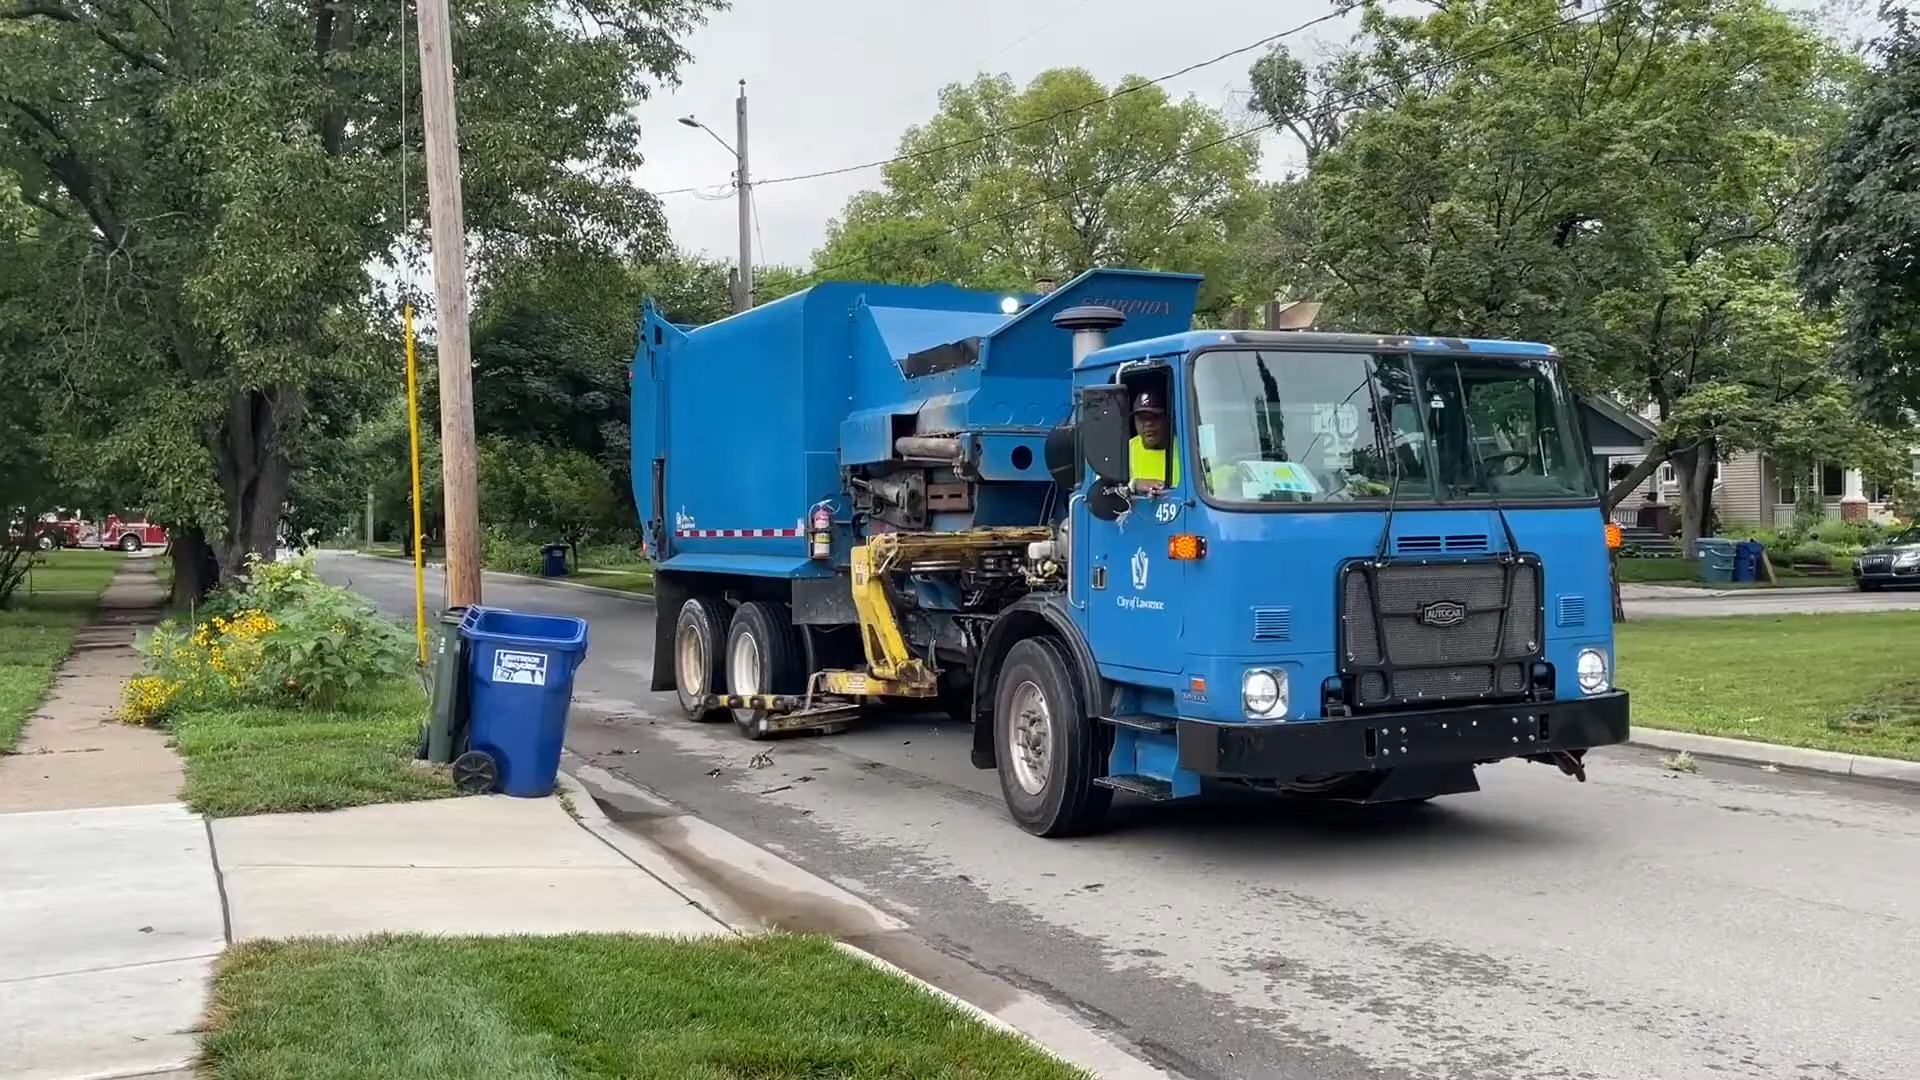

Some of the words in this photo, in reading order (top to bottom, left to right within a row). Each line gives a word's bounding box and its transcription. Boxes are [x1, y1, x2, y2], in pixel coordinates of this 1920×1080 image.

[1155, 503, 1176, 522] 459
[1116, 595, 1130, 610] City
[1136, 596, 1165, 610] Lawrence
[1427, 608, 1462, 619] AUTOCAR
[500, 651, 541, 665] Lawrence
